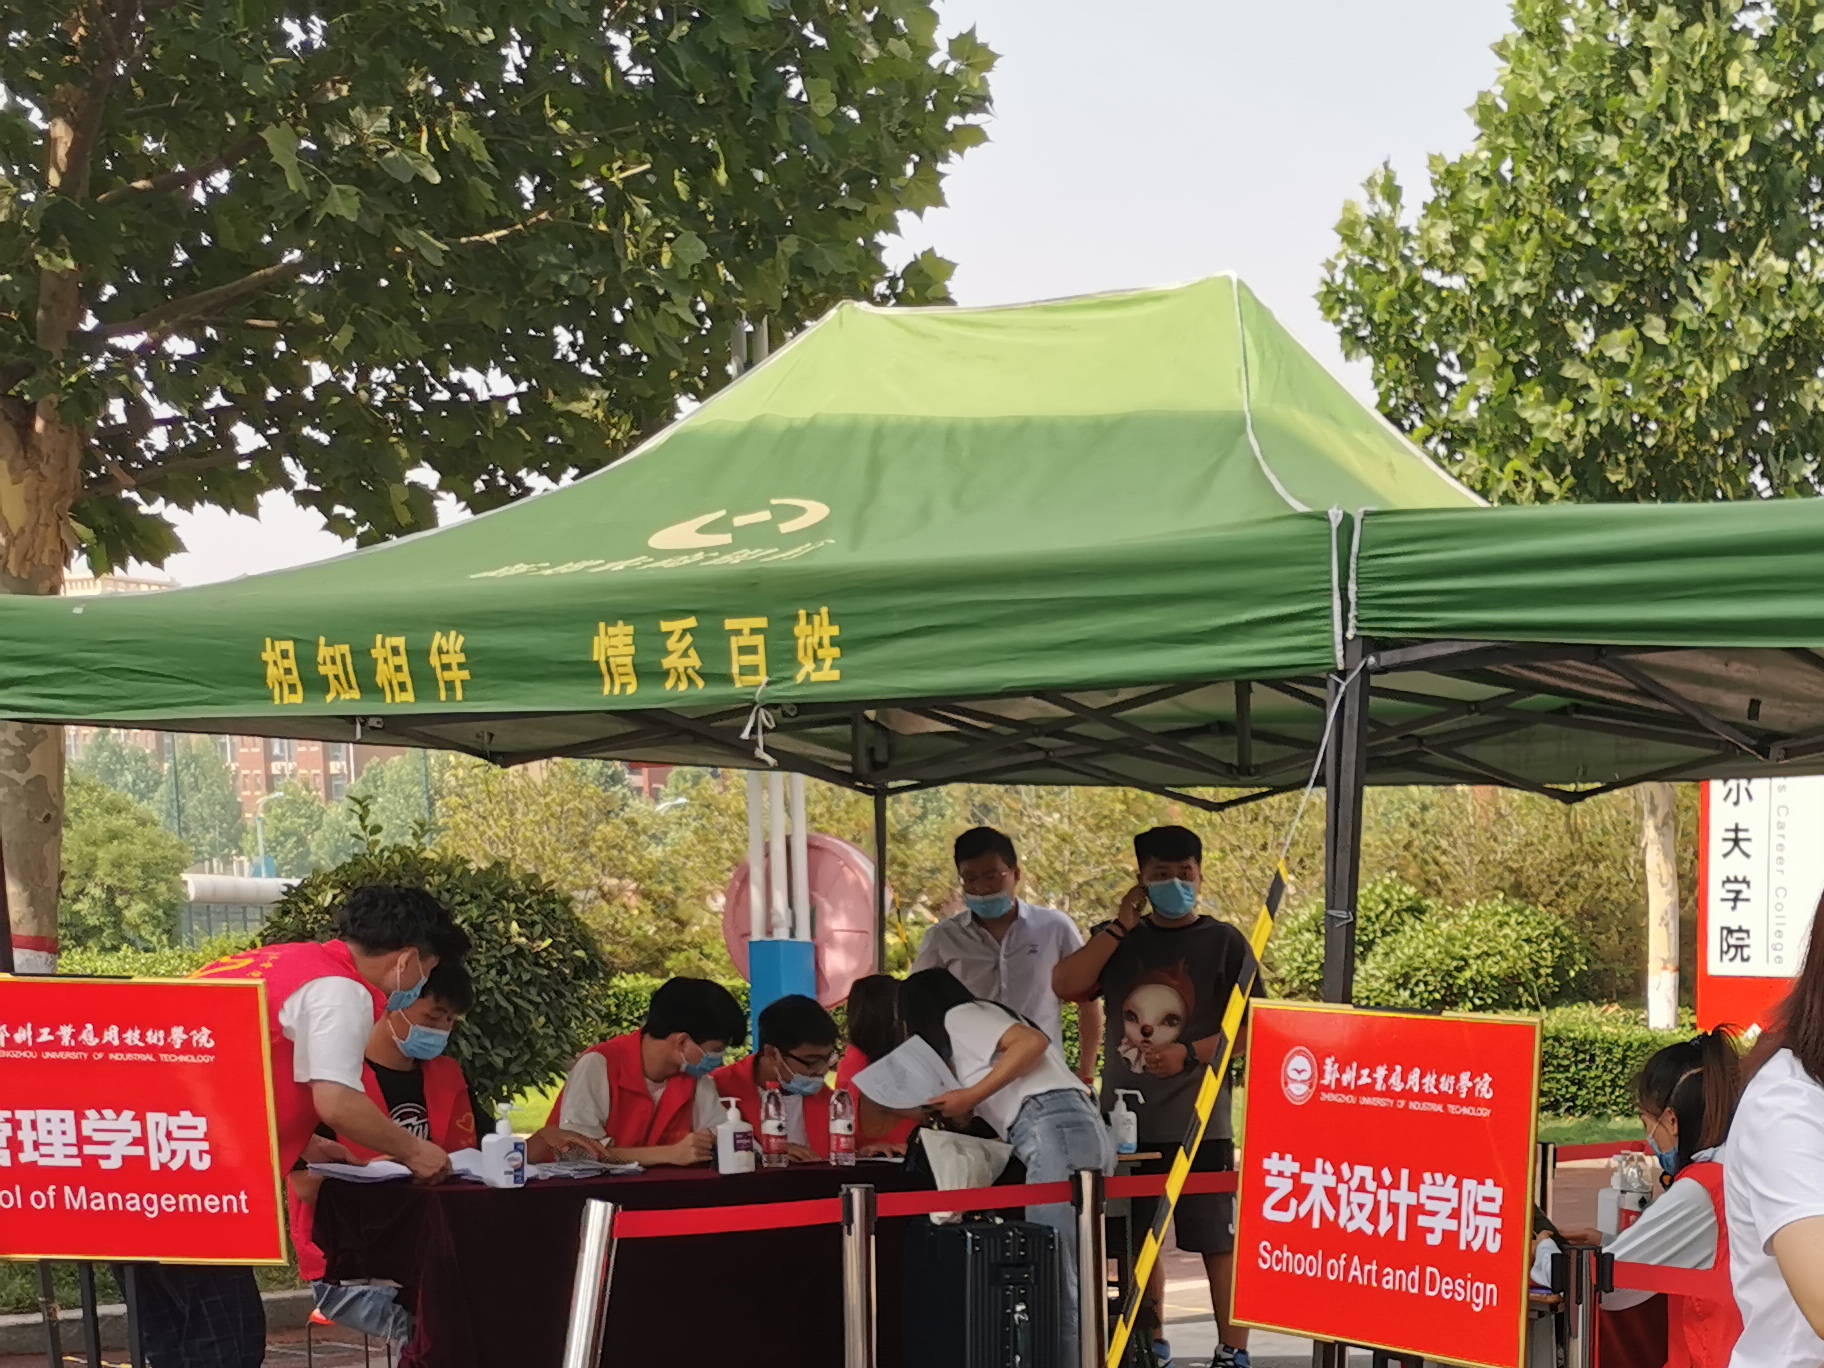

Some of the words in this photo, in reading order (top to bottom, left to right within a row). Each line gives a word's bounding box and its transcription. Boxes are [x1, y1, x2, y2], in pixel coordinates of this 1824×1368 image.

[262, 631, 470, 705] 相知相伴
[593, 608, 840, 695] 情系百姓
[1775, 804, 1789, 875] Career
[1771, 886, 1787, 965] College
[92, 1052, 104, 1061] OF
[0, 1109, 211, 1170] 理学院
[31, 1185, 56, 1209] of
[64, 1186, 248, 1218] Management
[1262, 1151, 1504, 1254] 艺术设计学院
[1258, 1240, 1323, 1278] School
[1326, 1252, 1346, 1282] of
[1348, 1255, 1378, 1287] Art
[1382, 1264, 1420, 1294] and
[1425, 1266, 1498, 1312] Design
